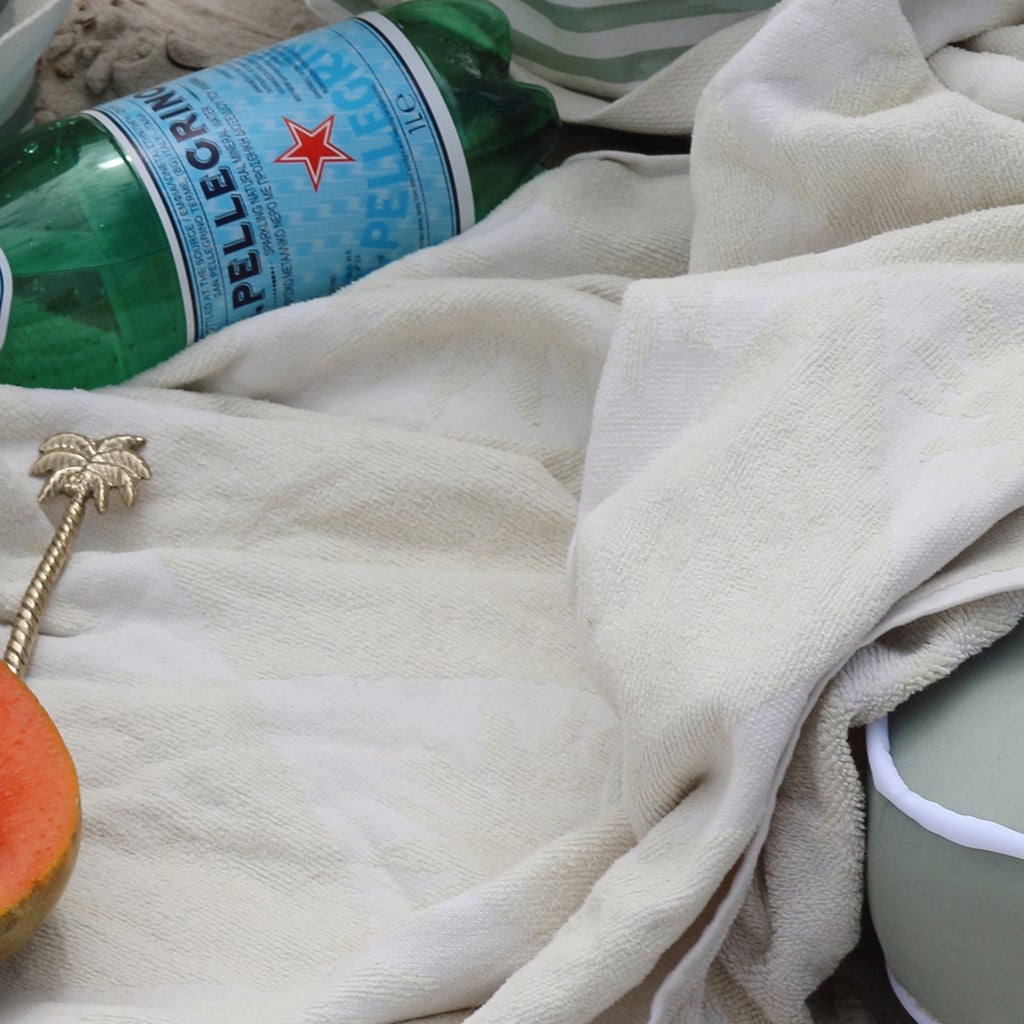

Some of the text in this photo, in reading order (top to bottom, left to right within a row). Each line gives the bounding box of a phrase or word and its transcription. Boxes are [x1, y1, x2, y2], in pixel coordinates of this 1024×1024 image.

[236, 163, 259, 205] NATURAL
[194, 215, 218, 278] PELLEGRINO
[252, 205, 275, 256] SPARKLING
